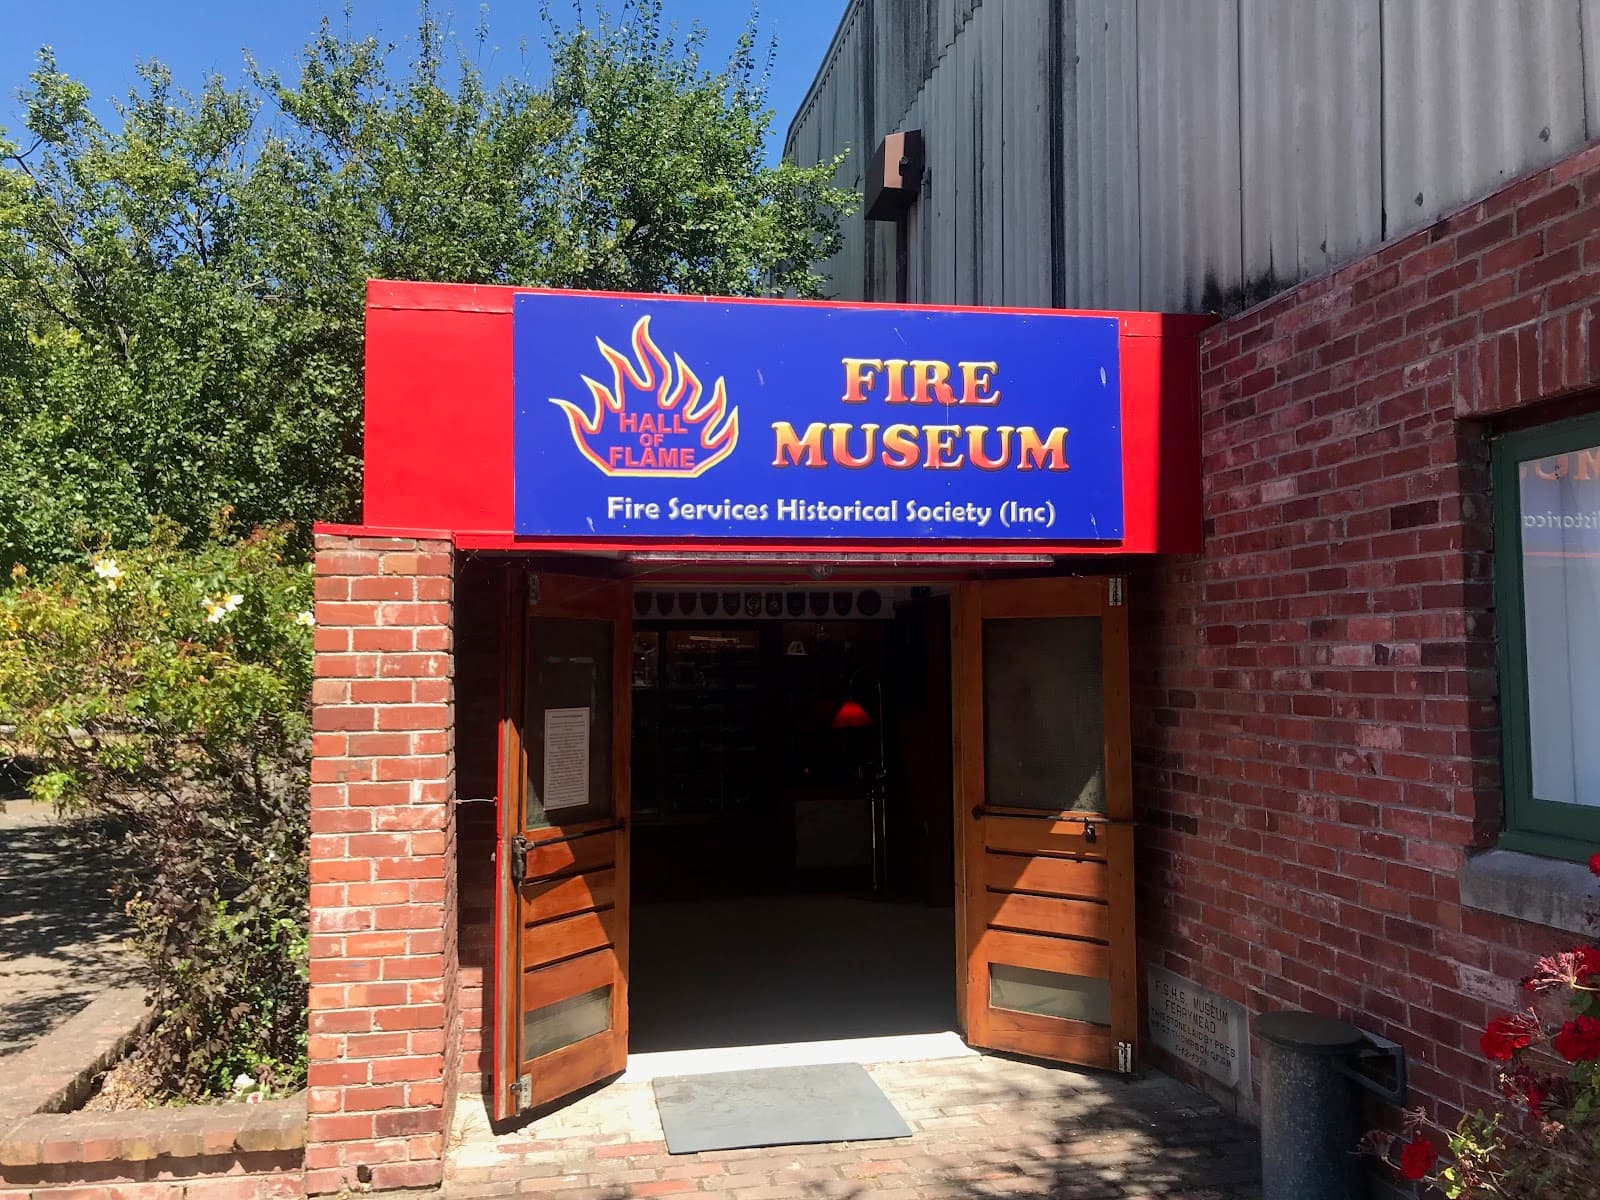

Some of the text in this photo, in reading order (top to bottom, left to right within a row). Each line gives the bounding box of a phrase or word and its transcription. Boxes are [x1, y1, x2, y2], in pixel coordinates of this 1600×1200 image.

[842, 357, 1001, 406] FIRE
[619, 412, 689, 434] HALL
[639, 433, 664, 447] OF
[771, 421, 1070, 472] MUSEUM
[609, 446, 696, 468] FLAME
[607, 496, 1056, 528] Fire Services Historical Society (Inc)
[1165, 999, 1216, 1034] FERRYMEAD
[1193, 997, 1229, 1024] MUSEUM
